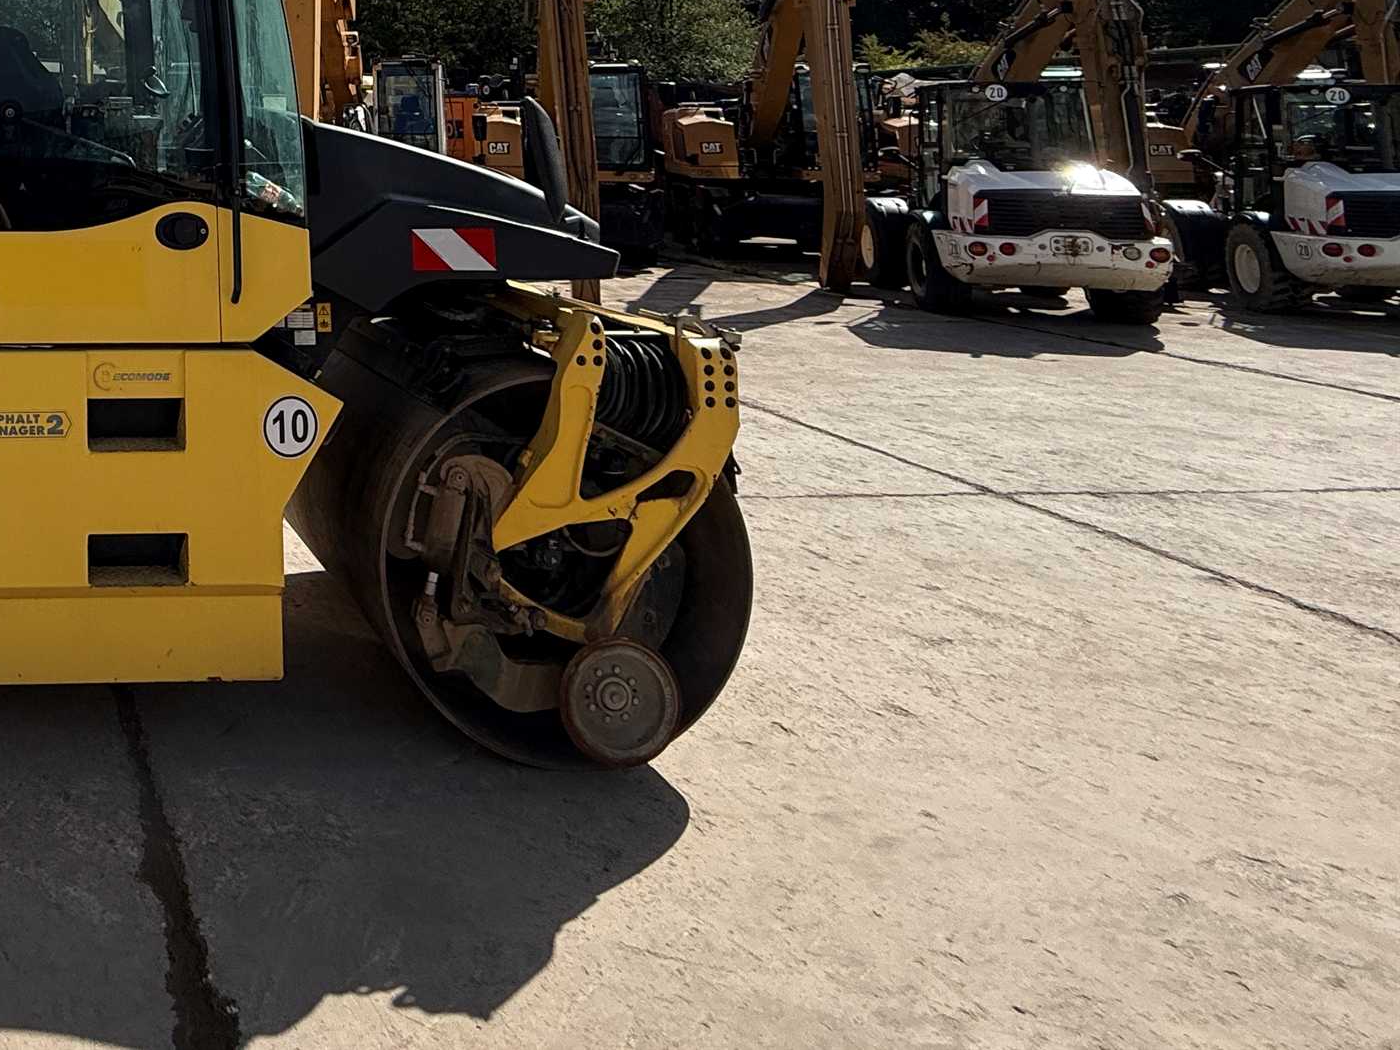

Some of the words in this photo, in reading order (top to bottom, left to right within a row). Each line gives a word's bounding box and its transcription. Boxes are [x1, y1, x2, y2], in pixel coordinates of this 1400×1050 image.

[1246, 53, 1262, 81] CAT
[990, 87, 1004, 99] 20
[1330, 89, 1346, 102] 20
[488, 142, 509, 154] CAT
[702, 142, 721, 153] CAT
[1150, 144, 1173, 156] CAT
[46, 414, 65, 436] 2
[272, 409, 309, 444] 10
